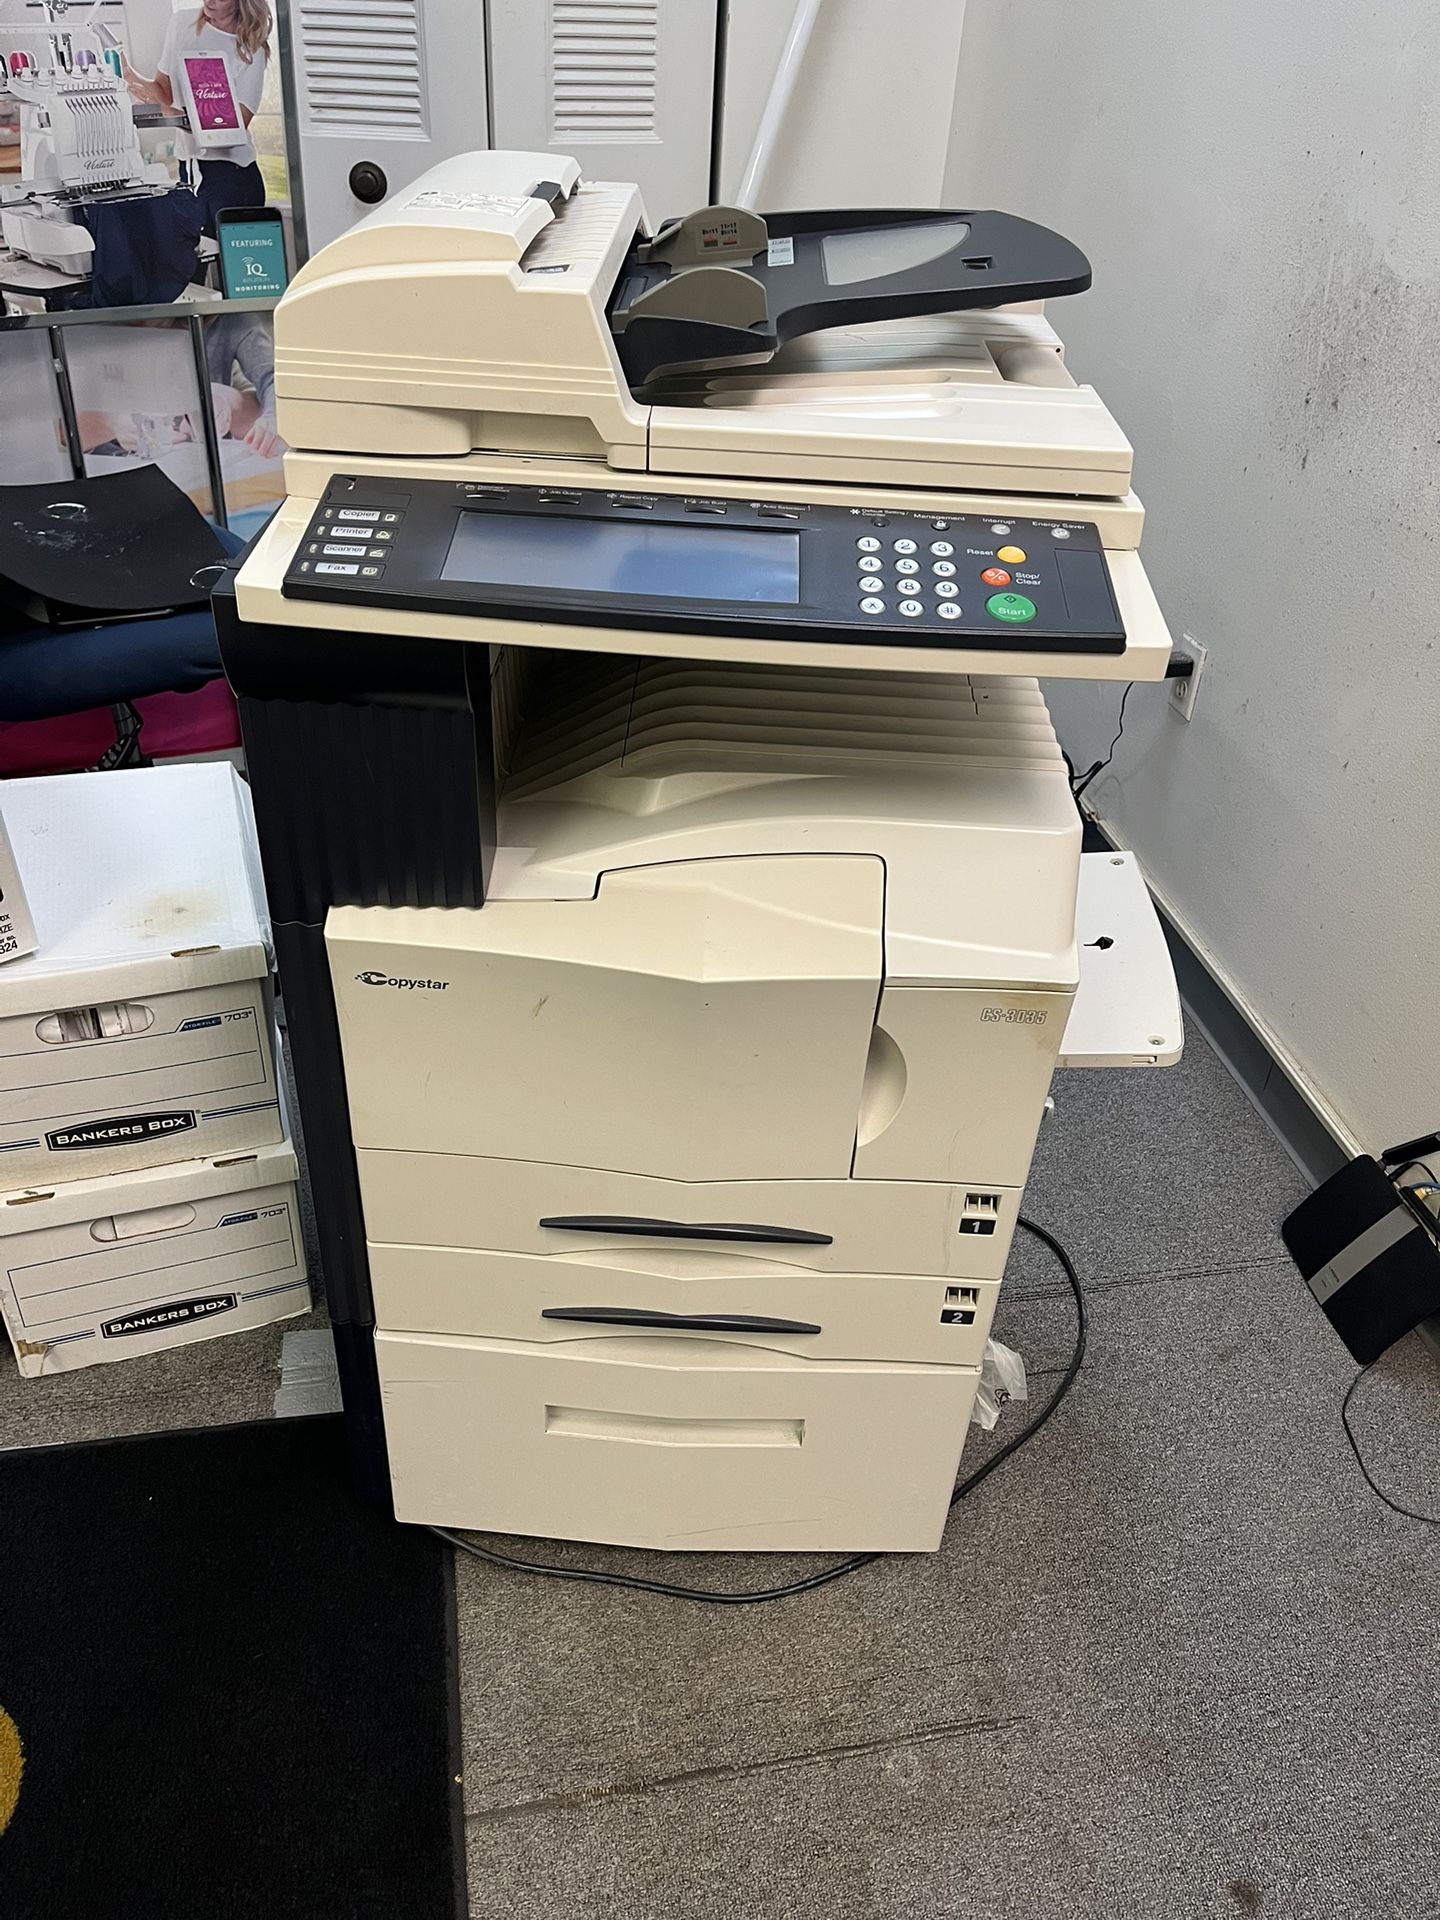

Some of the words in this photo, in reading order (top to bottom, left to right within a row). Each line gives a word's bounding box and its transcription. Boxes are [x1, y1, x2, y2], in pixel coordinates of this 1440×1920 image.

[231, 239, 273, 247] FEATURING
[246, 263, 268, 277] IQ
[235, 284, 280, 292] MONITORING
[343, 510, 376, 518] Copier
[913, 513, 966, 521] Management
[982, 517, 1016, 525] Interrupt
[900, 541, 911, 550] 2
[937, 543, 948, 552] 3
[966, 548, 994, 556] Reset
[864, 559, 873, 567] 4
[902, 561, 912, 570] 5
[939, 563, 949, 572] 6
[1015, 572, 1041, 580] Stop/
[867, 579, 875, 588] 7
[904, 581, 914, 591] 8
[942, 583, 952, 593] 9
[1015, 578, 1041, 586] Clear
[906, 602, 916, 612] 0
[998, 607, 1026, 616] Start
[354, 971, 450, 990] Copystar
[980, 1007, 1047, 1025] CS-3035
[56, 1125, 144, 1145] BANKERS
[148, 1117, 186, 1131] BOX
[972, 1221, 980, 1233] 1
[110, 1308, 189, 1333] BANKERS
[193, 1299, 228, 1313] BOX
[951, 1312, 963, 1323] 2
